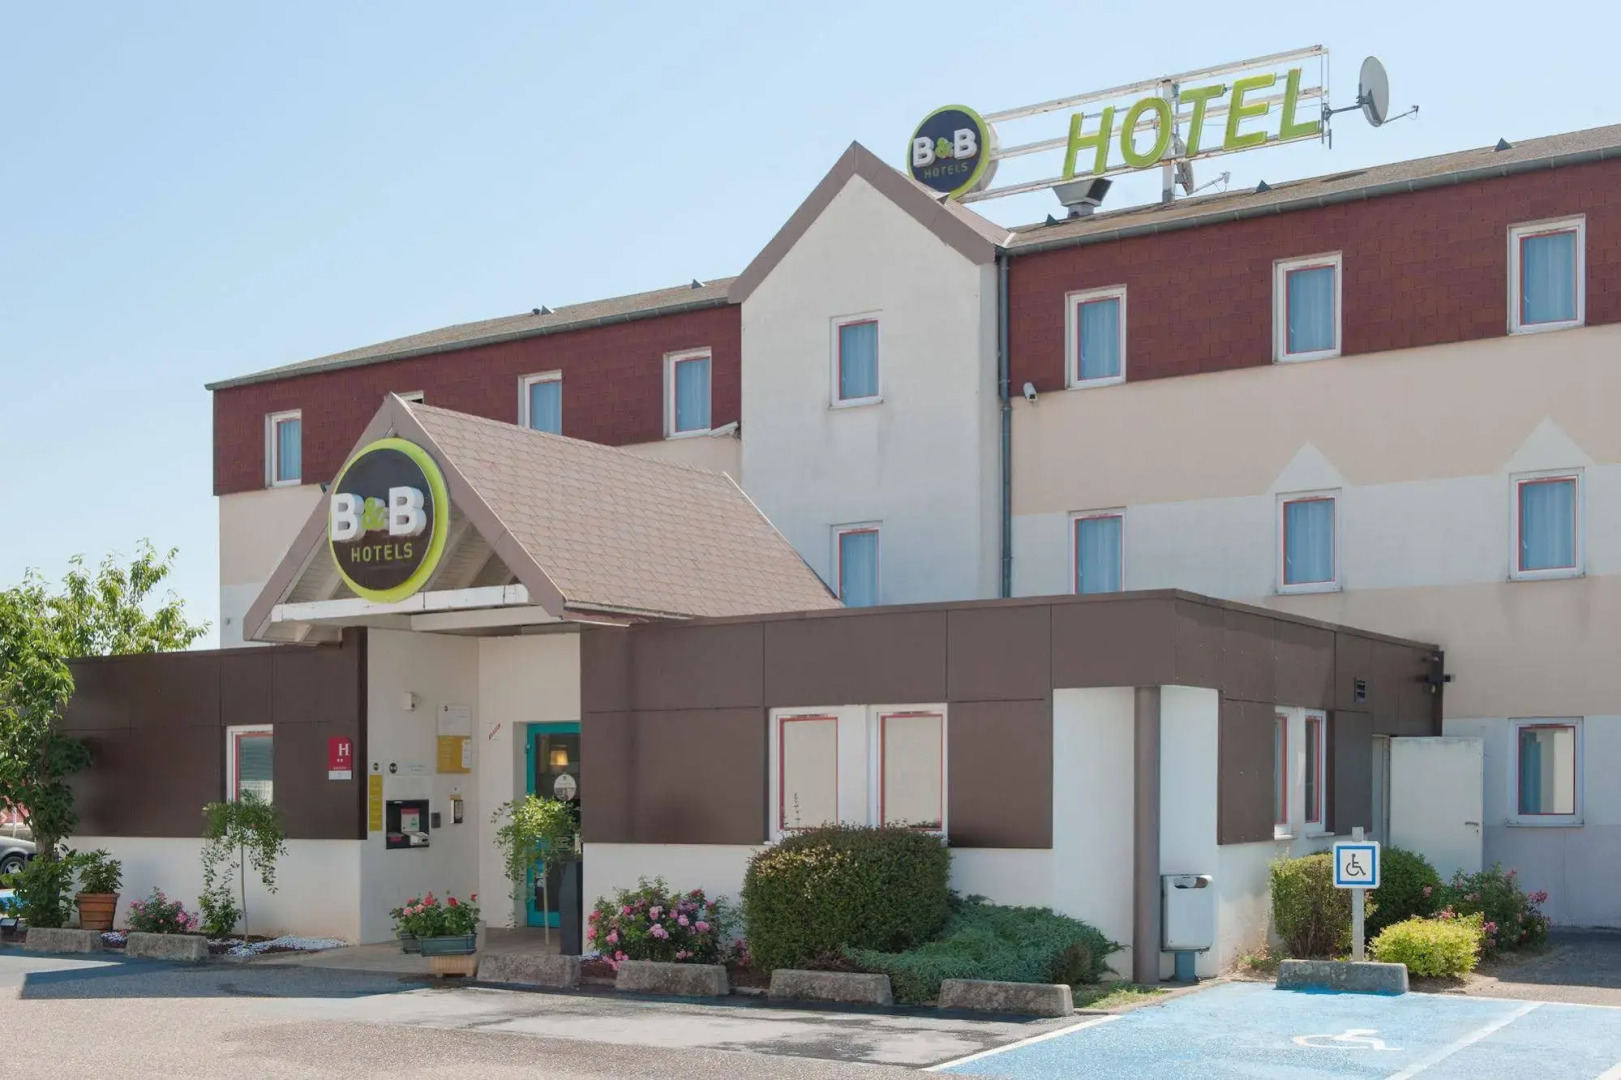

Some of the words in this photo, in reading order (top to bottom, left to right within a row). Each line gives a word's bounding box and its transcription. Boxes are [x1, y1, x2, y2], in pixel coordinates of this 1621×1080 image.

[1061, 67, 1322, 180] HOTEL
[912, 127, 978, 168] B&B
[924, 162, 968, 179] HOTELS
[331, 485, 428, 542] B&B
[351, 543, 413, 562] HOTELS
[338, 743, 349, 756] H
